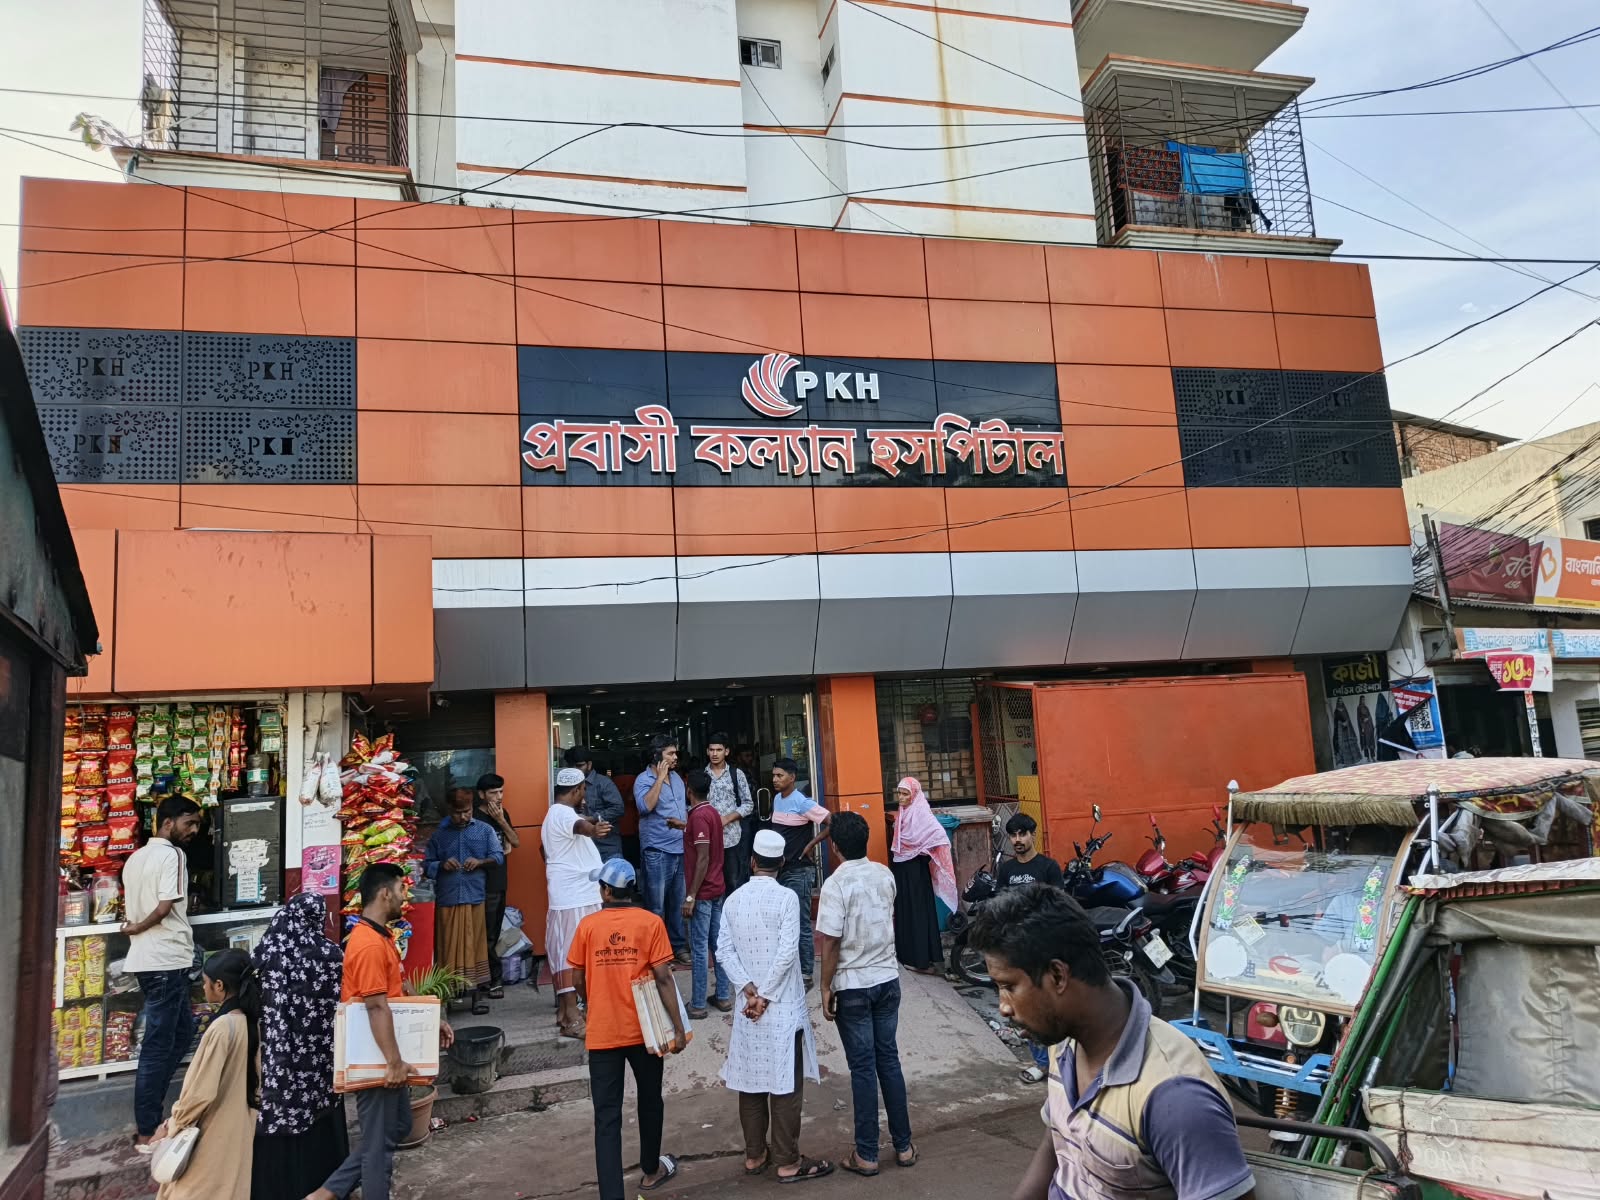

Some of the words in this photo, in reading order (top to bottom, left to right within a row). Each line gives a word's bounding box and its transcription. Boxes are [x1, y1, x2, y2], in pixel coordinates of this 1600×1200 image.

[76, 357, 125, 376] PKH
[247, 361, 294, 380] PKH
[795, 371, 880, 400] PKH
[522, 404, 679, 473] প্রবাসী
[690, 424, 857, 476] কল্যান
[866, 412, 1064, 478] হসপিটাল
